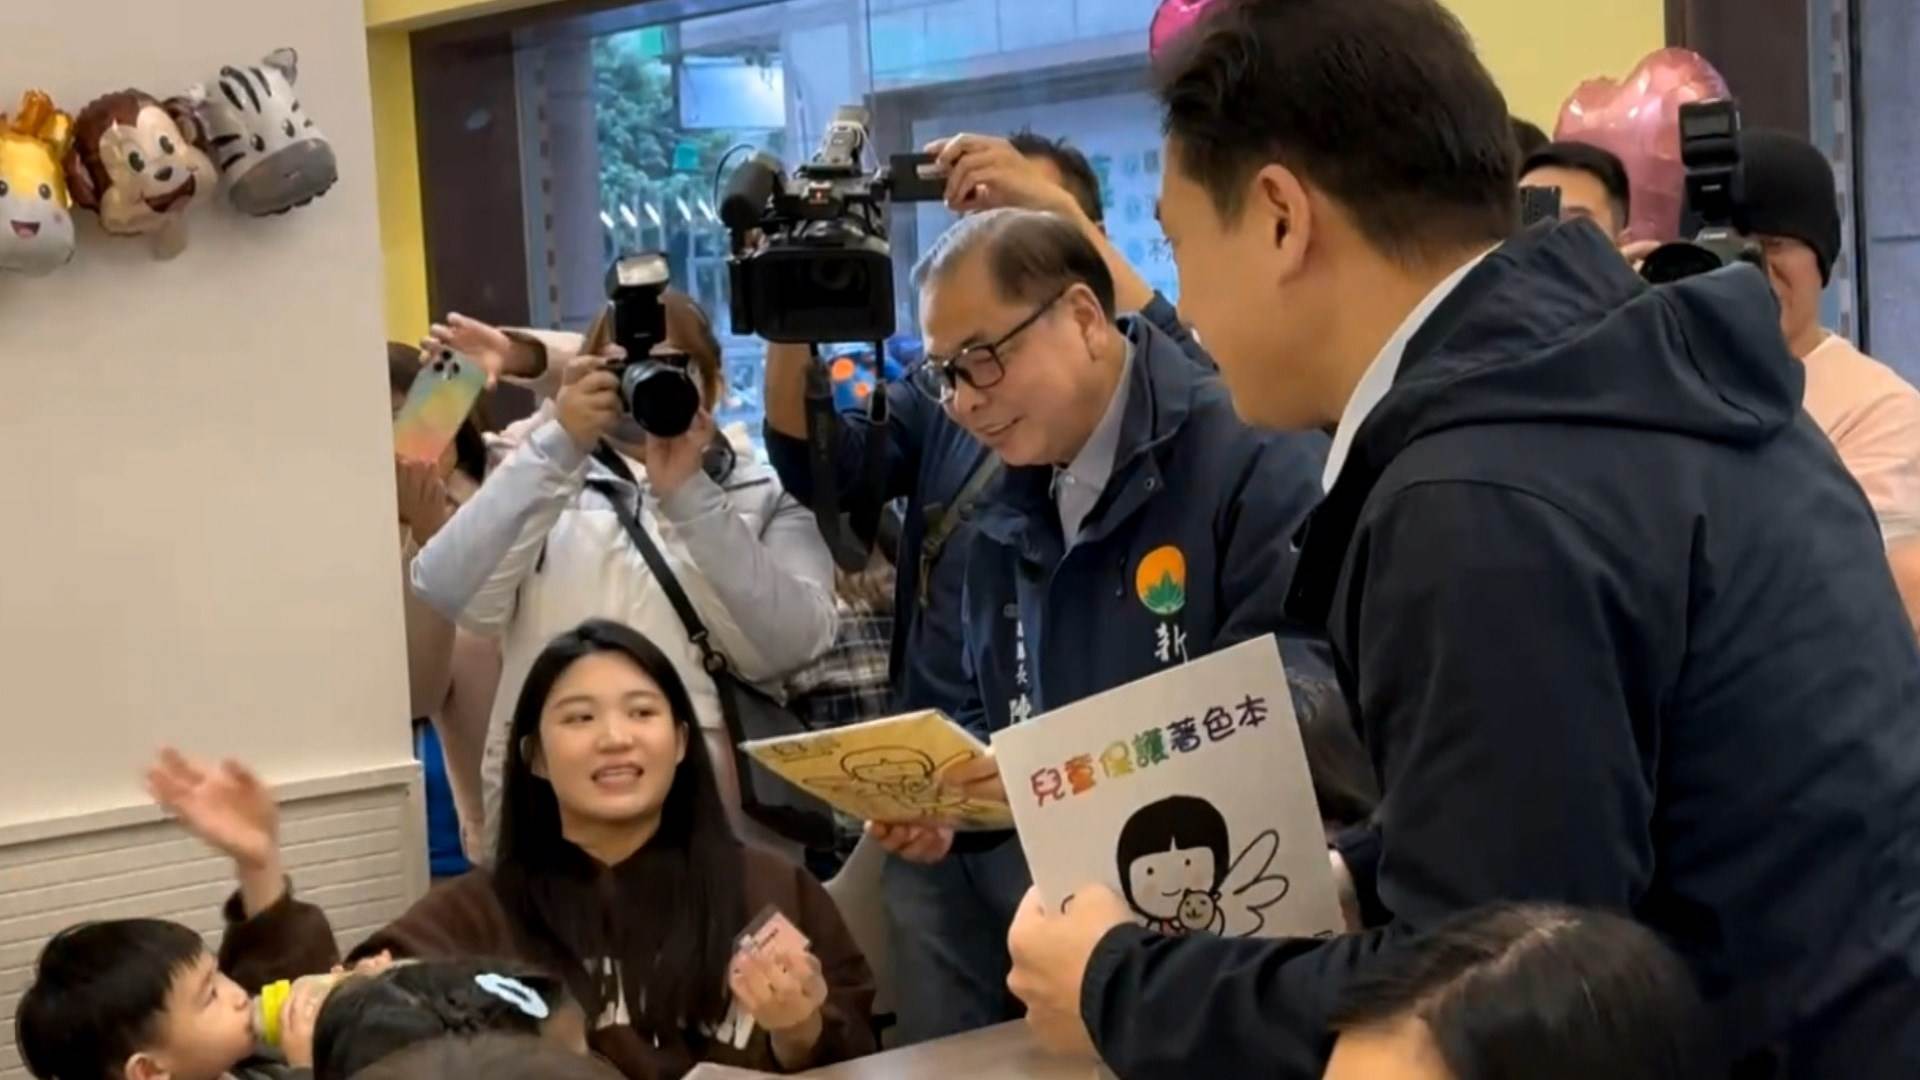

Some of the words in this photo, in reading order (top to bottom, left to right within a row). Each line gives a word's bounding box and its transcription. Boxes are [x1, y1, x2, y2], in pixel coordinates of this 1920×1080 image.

[1154, 621, 1188, 665] 新
[1030, 694, 1268, 807] 兒童保護著色本
